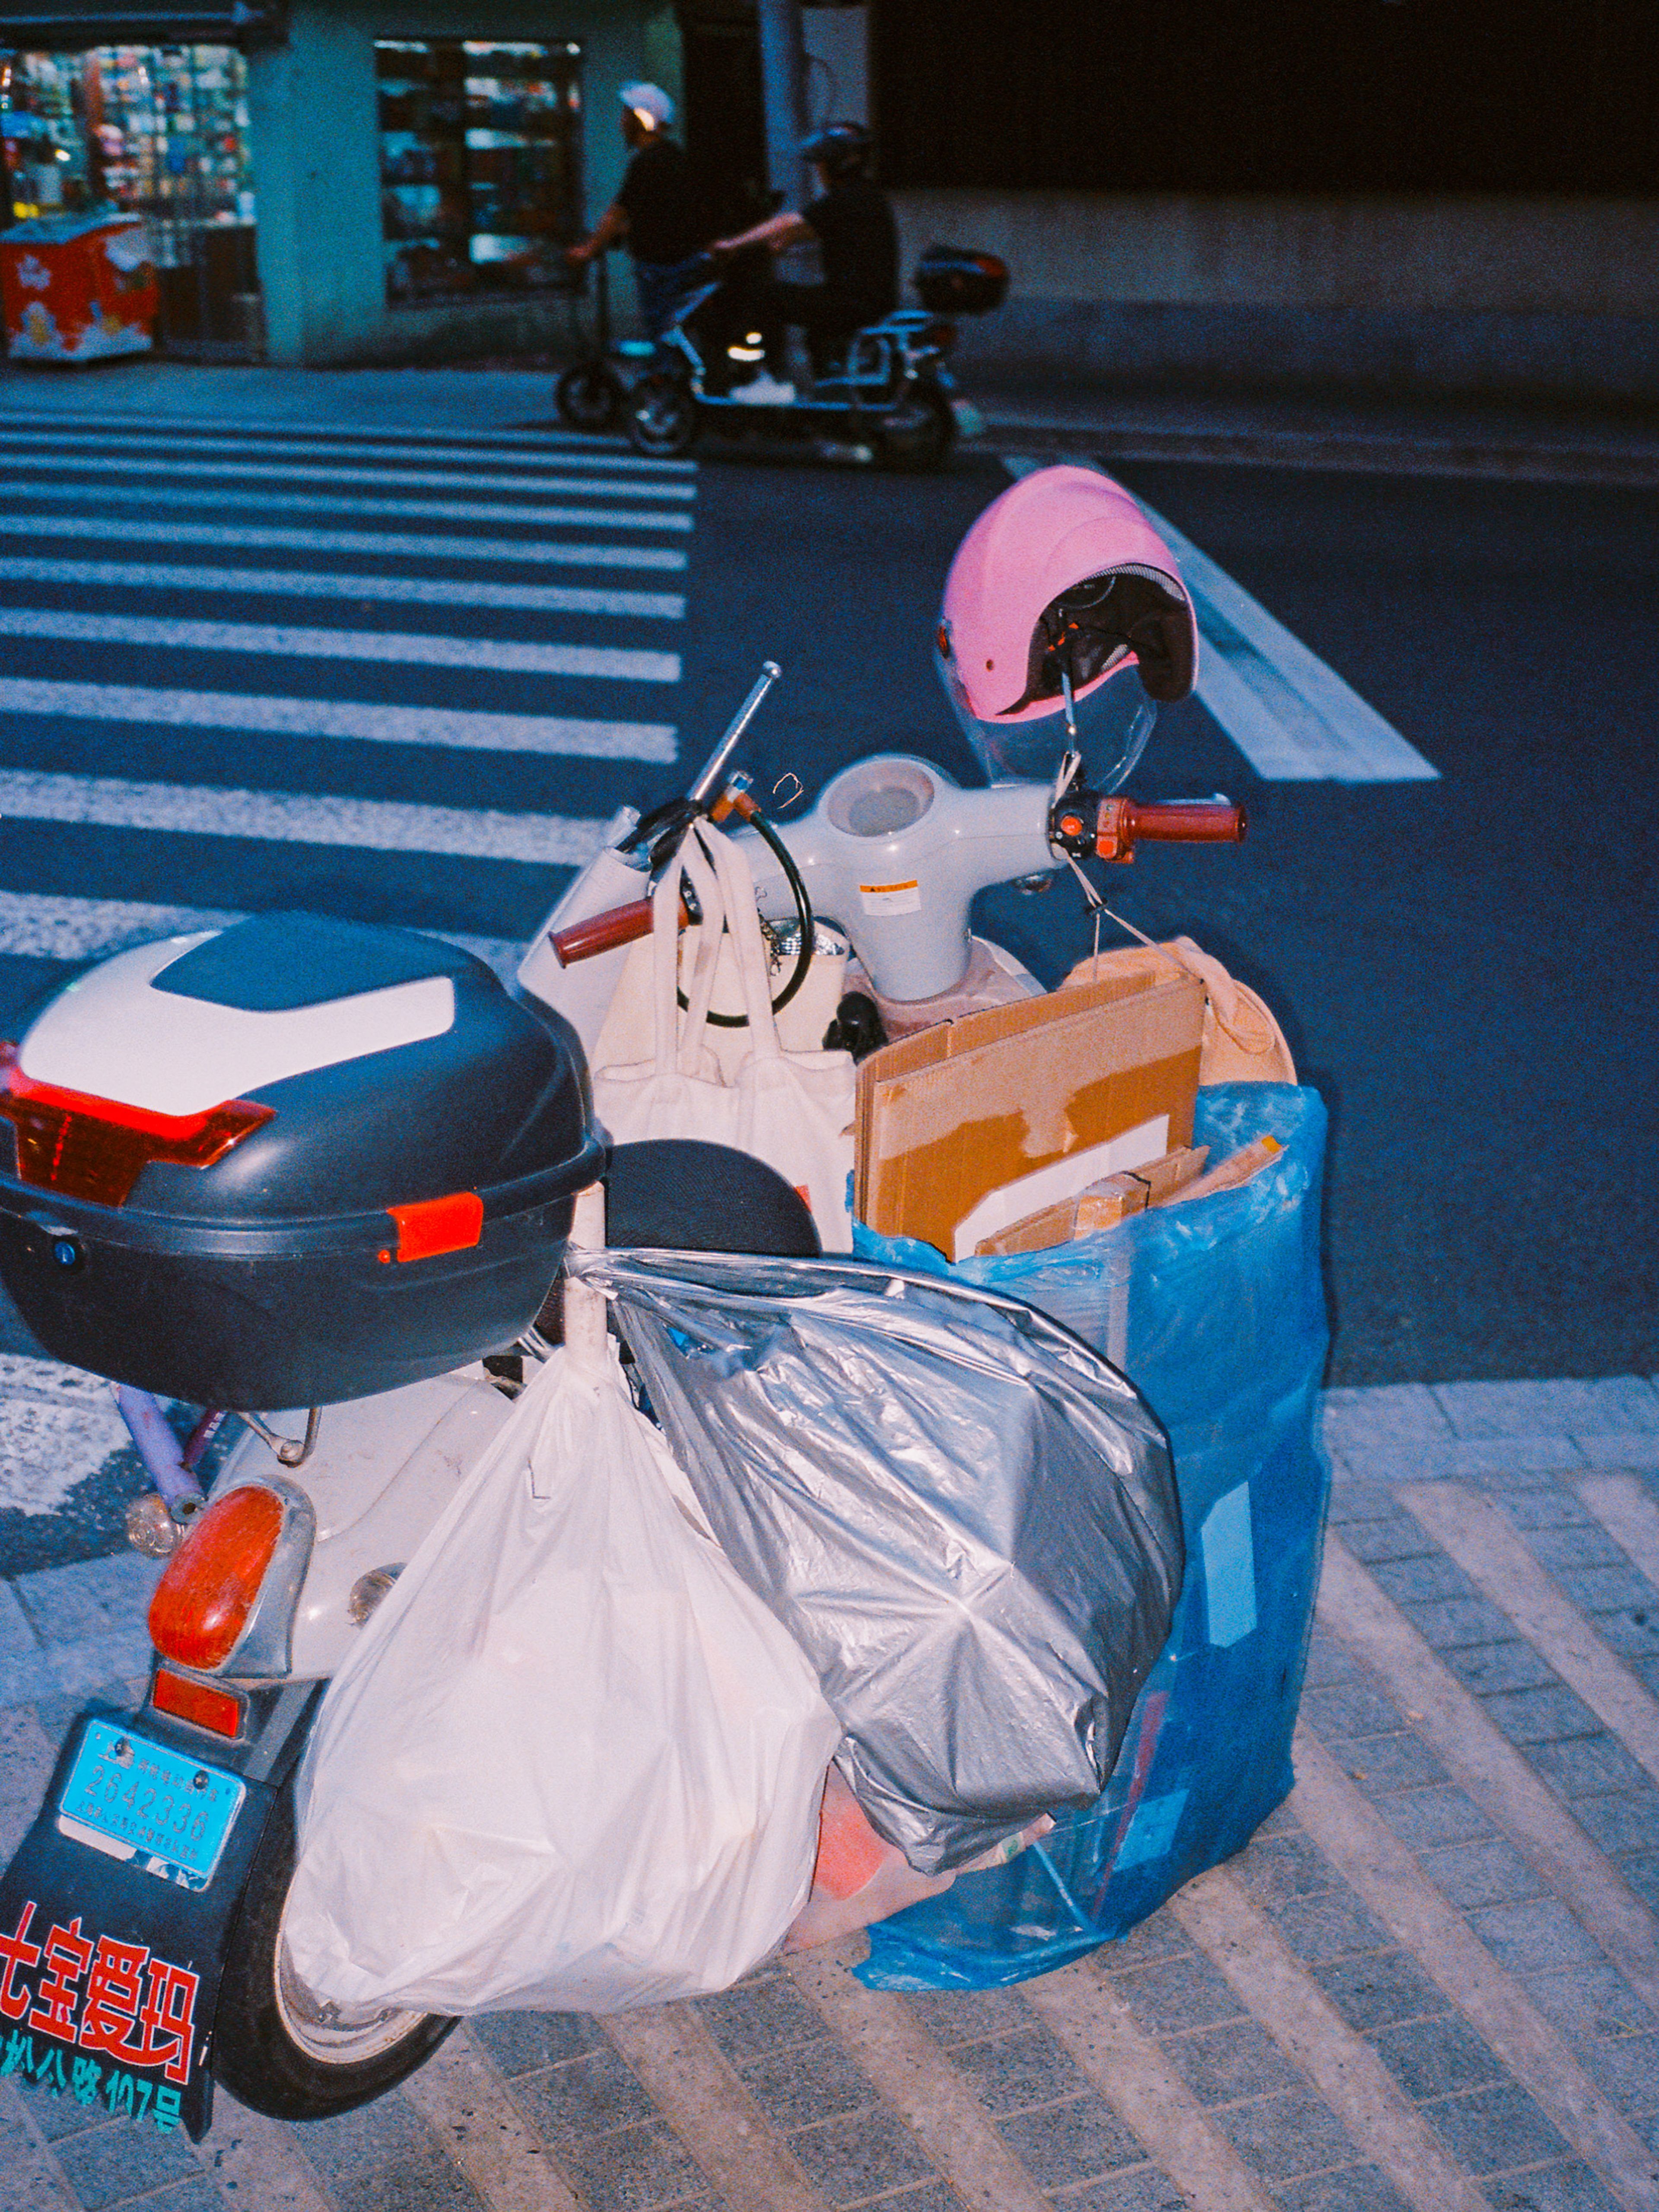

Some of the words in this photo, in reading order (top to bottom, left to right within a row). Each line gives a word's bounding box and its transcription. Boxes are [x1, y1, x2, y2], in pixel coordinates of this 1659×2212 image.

[85, 1765, 208, 1841] 2642336
[0, 1901, 200, 2085] 七宝爱玛
[0, 2029, 181, 2134] 松公路107号
